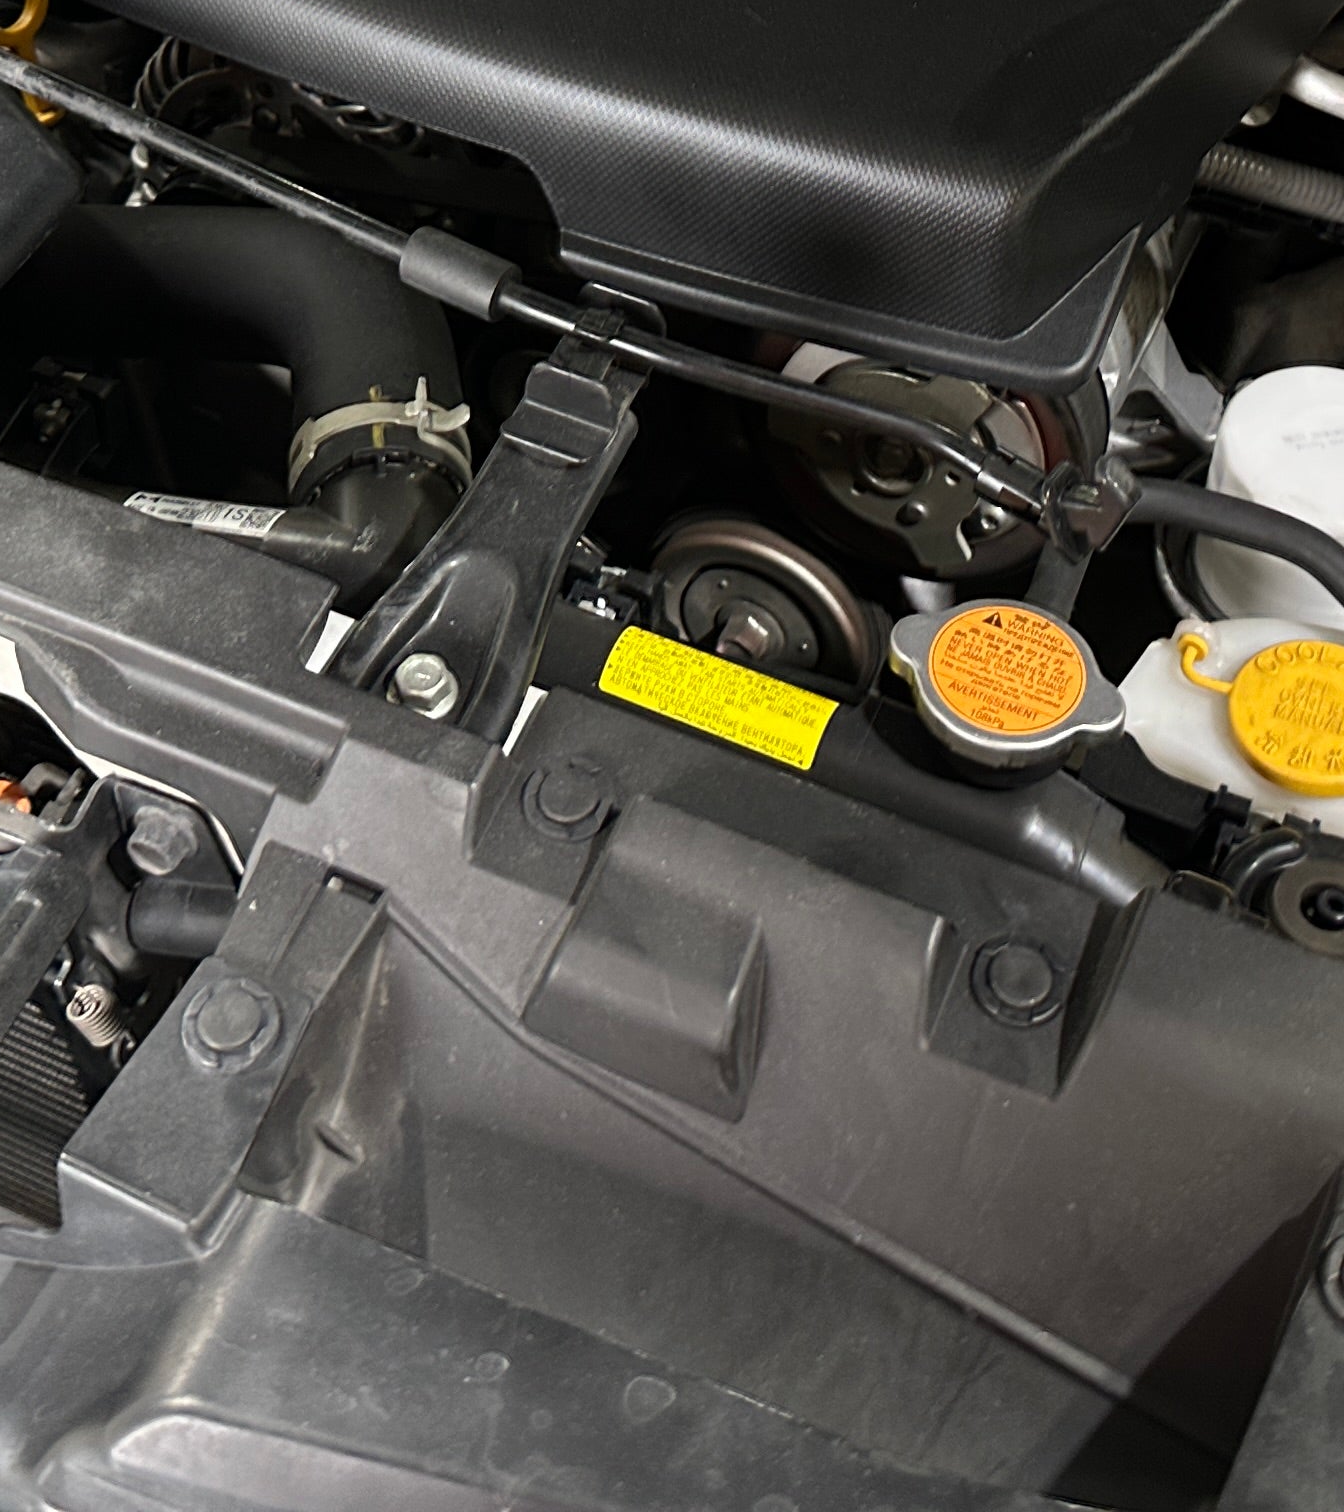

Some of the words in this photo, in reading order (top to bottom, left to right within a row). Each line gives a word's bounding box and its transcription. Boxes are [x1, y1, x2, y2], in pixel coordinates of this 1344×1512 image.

[1006, 618, 1065, 647] WARNING
[949, 634, 983, 654] NEVER
[984, 647, 1013, 666] OPEN
[1015, 659, 1046, 679] WHEN
[947, 678, 1040, 722] AVERTISSEMENT
[969, 708, 1006, 729] 108kPa
